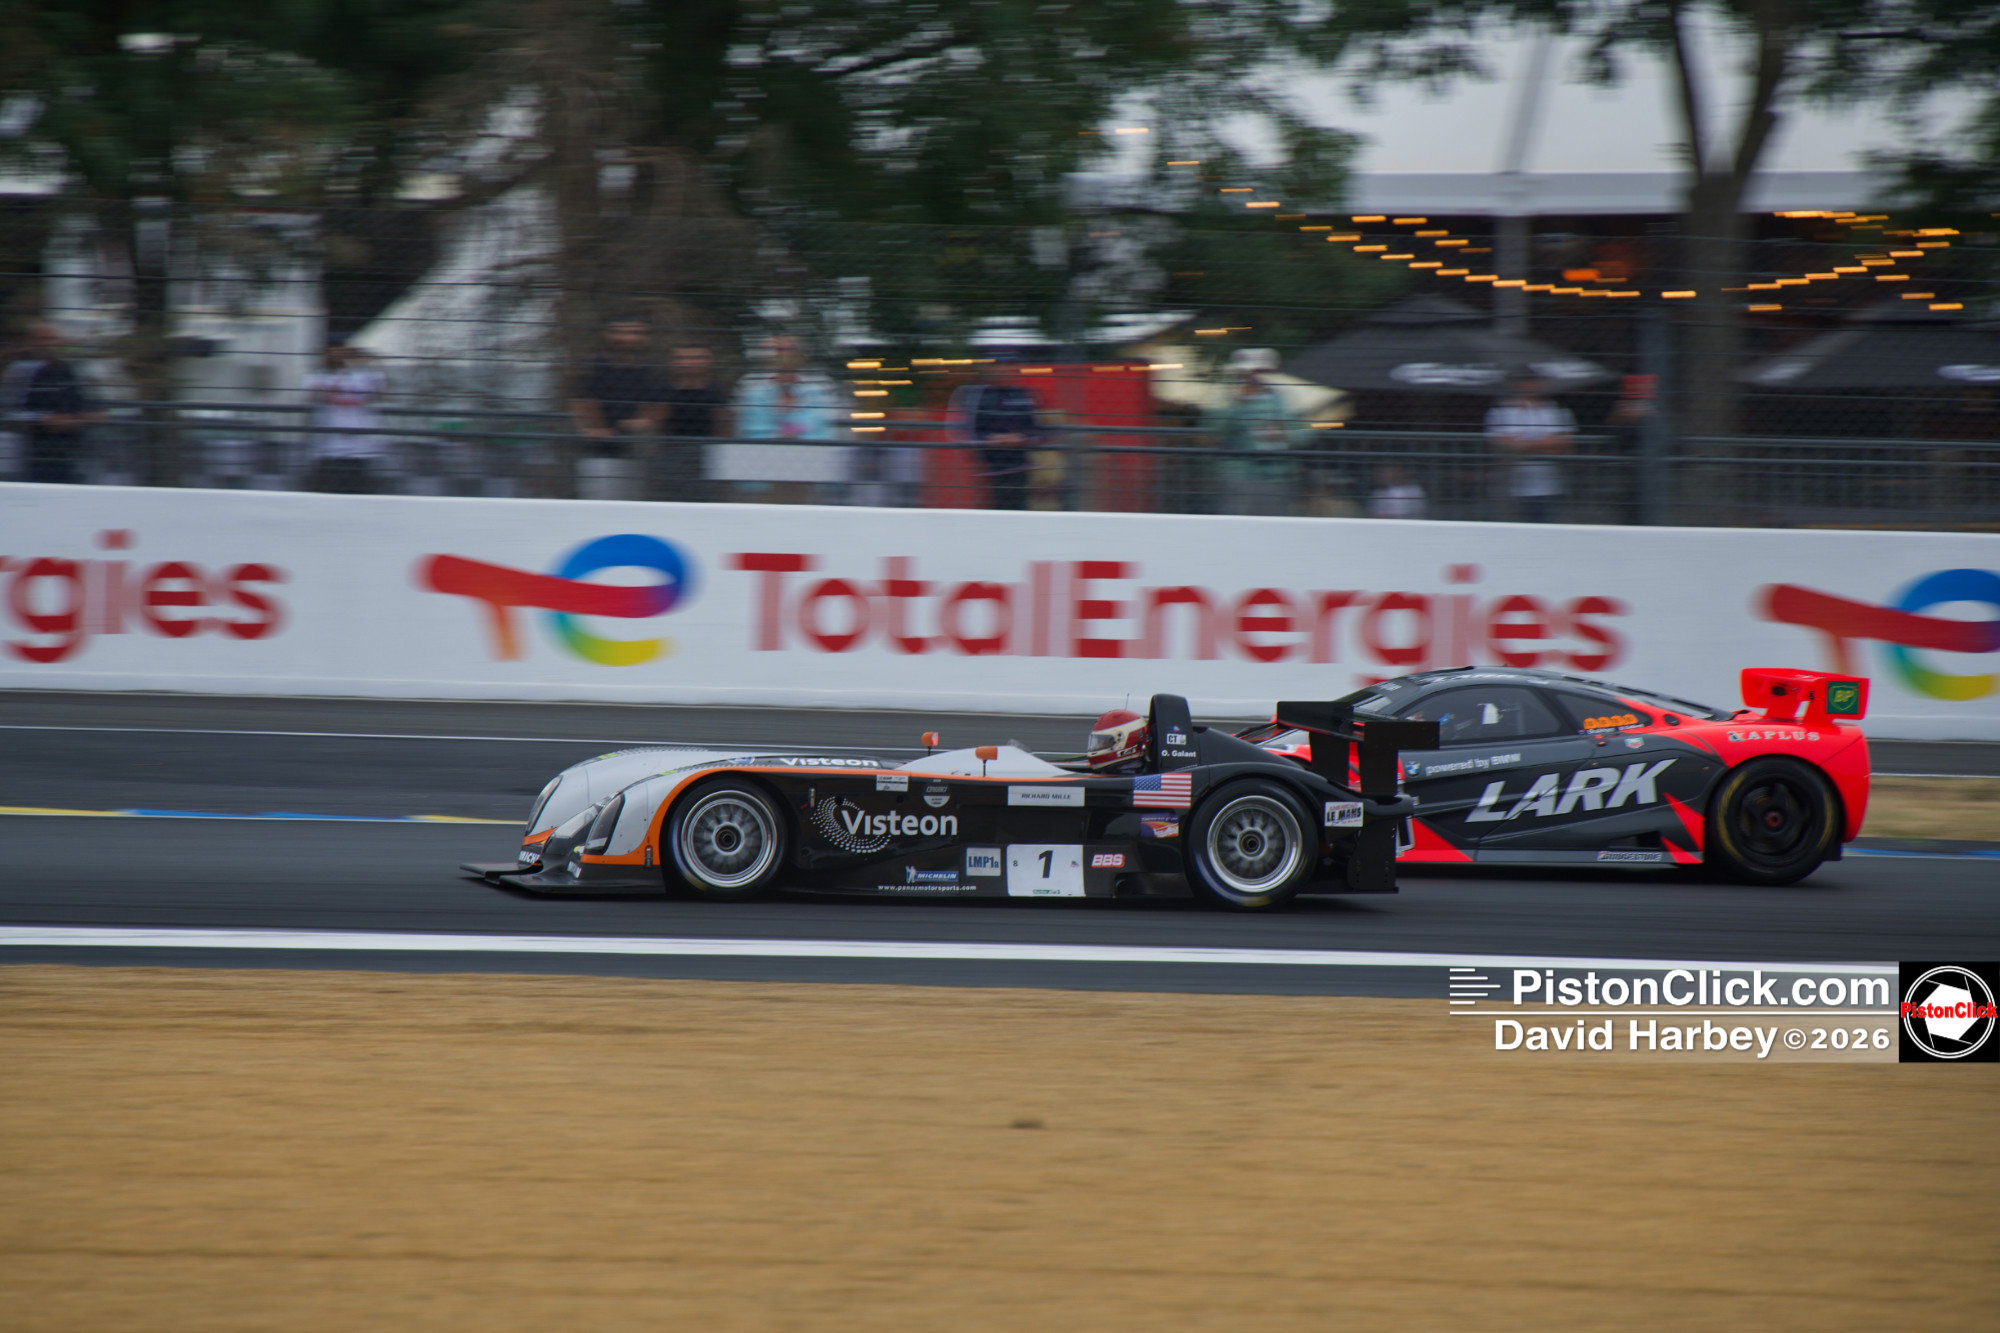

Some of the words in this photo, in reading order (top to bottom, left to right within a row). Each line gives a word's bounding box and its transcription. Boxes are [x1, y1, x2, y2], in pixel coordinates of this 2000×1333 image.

[0, 528, 291, 663] gies
[724, 552, 1631, 688] TotalEnergies
[1833, 690, 1855, 702] BP
[779, 757, 879, 767] Visteon
[1161, 749, 1170, 757] O.
[1172, 749, 1197, 757] Galant
[1425, 759, 1474, 776] powered
[1474, 758, 1490, 769] by
[1465, 758, 1679, 823] LARK
[841, 810, 958, 836] Visteon
[968, 856, 1000, 868] LMP1a
[1038, 850, 1054, 879] 1
[1091, 854, 1124, 867] BBS
